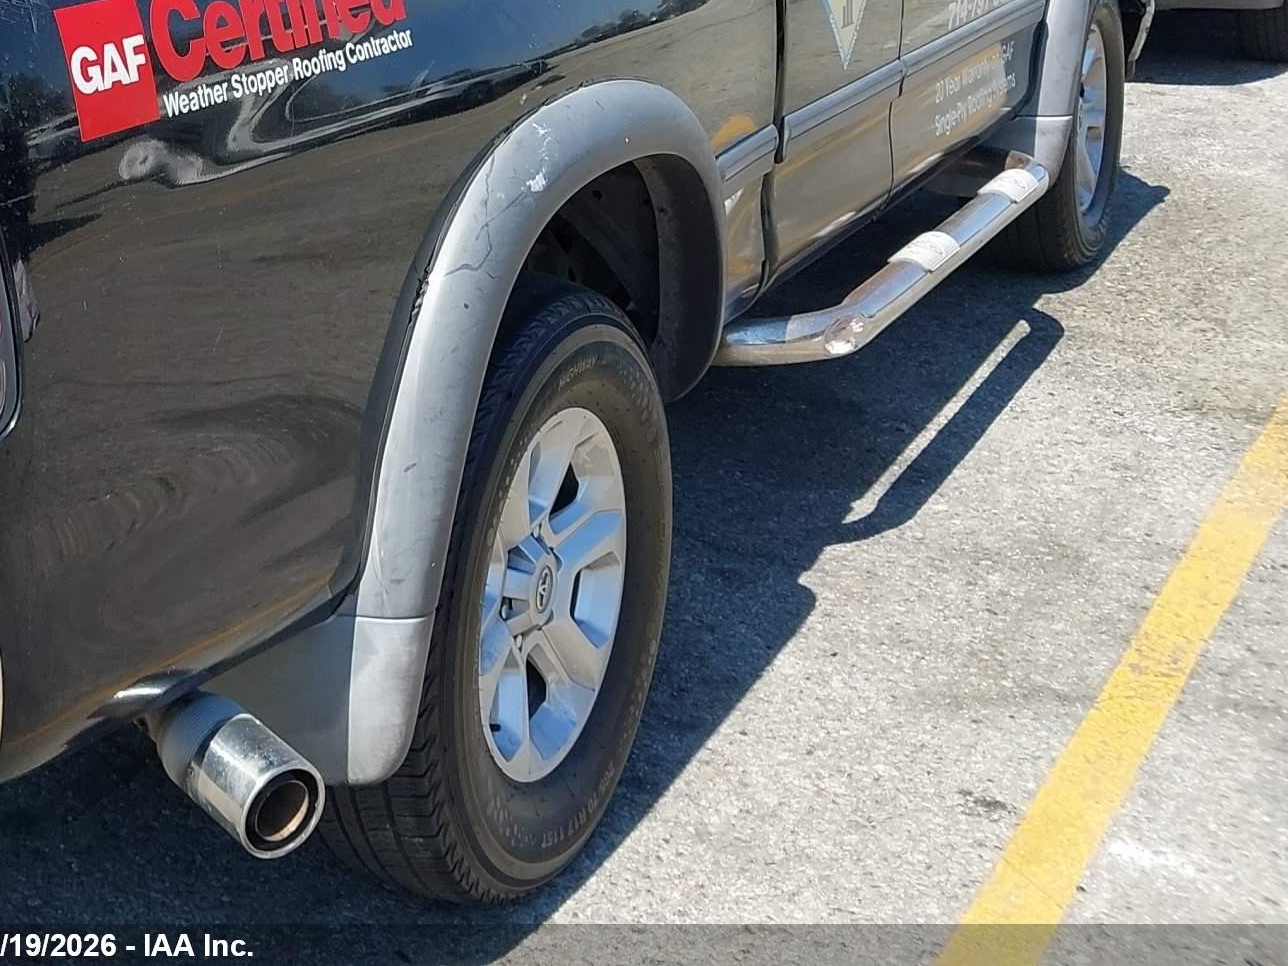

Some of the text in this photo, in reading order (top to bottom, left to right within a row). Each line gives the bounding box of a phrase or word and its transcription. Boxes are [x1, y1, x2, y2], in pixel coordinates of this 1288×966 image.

[70, 34, 146, 95] GAF
[163, 27, 414, 118] Weather Stopper Roofing Contractor
